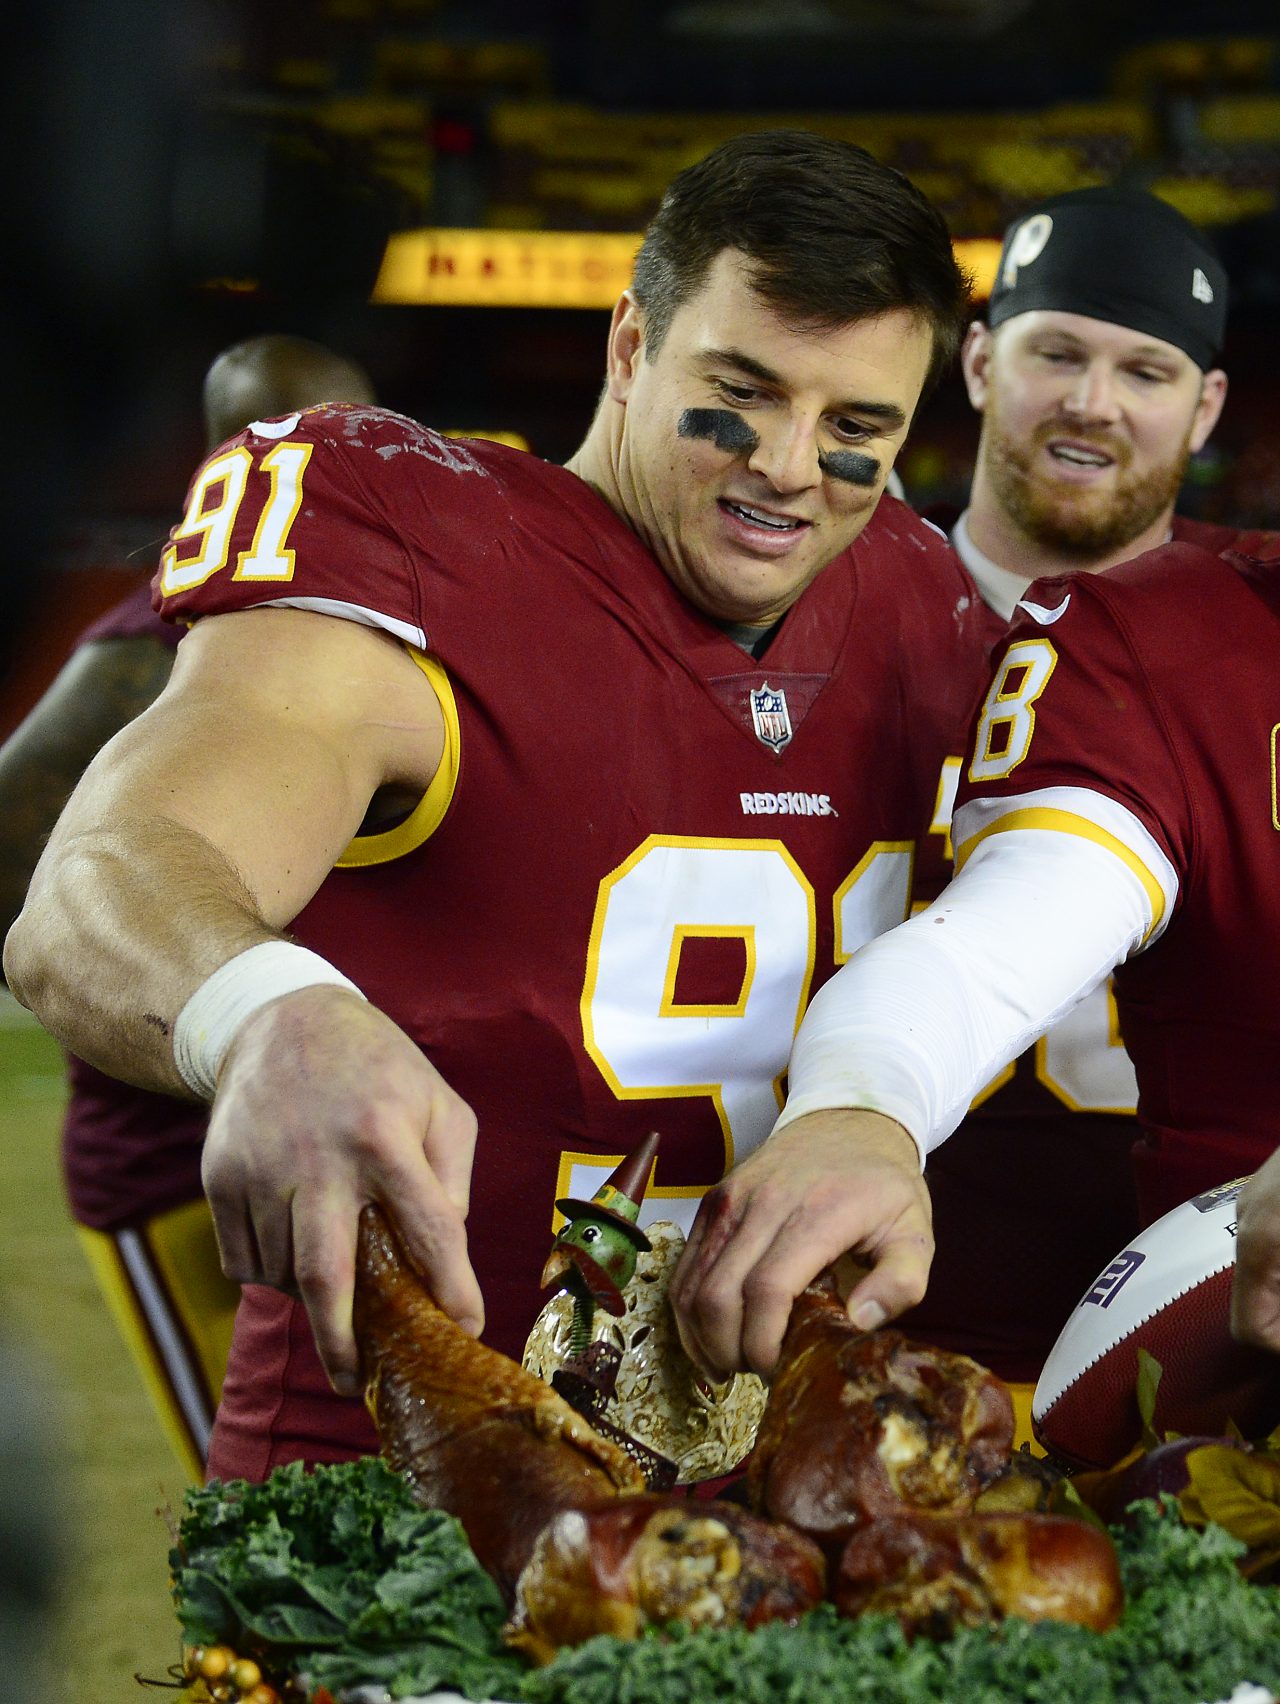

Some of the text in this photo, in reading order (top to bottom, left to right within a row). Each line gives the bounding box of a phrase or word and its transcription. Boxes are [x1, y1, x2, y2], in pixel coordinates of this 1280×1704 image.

[161, 442, 313, 598] 91
[967, 637, 1058, 783] 8
[739, 791, 836, 818] REDSKINS
